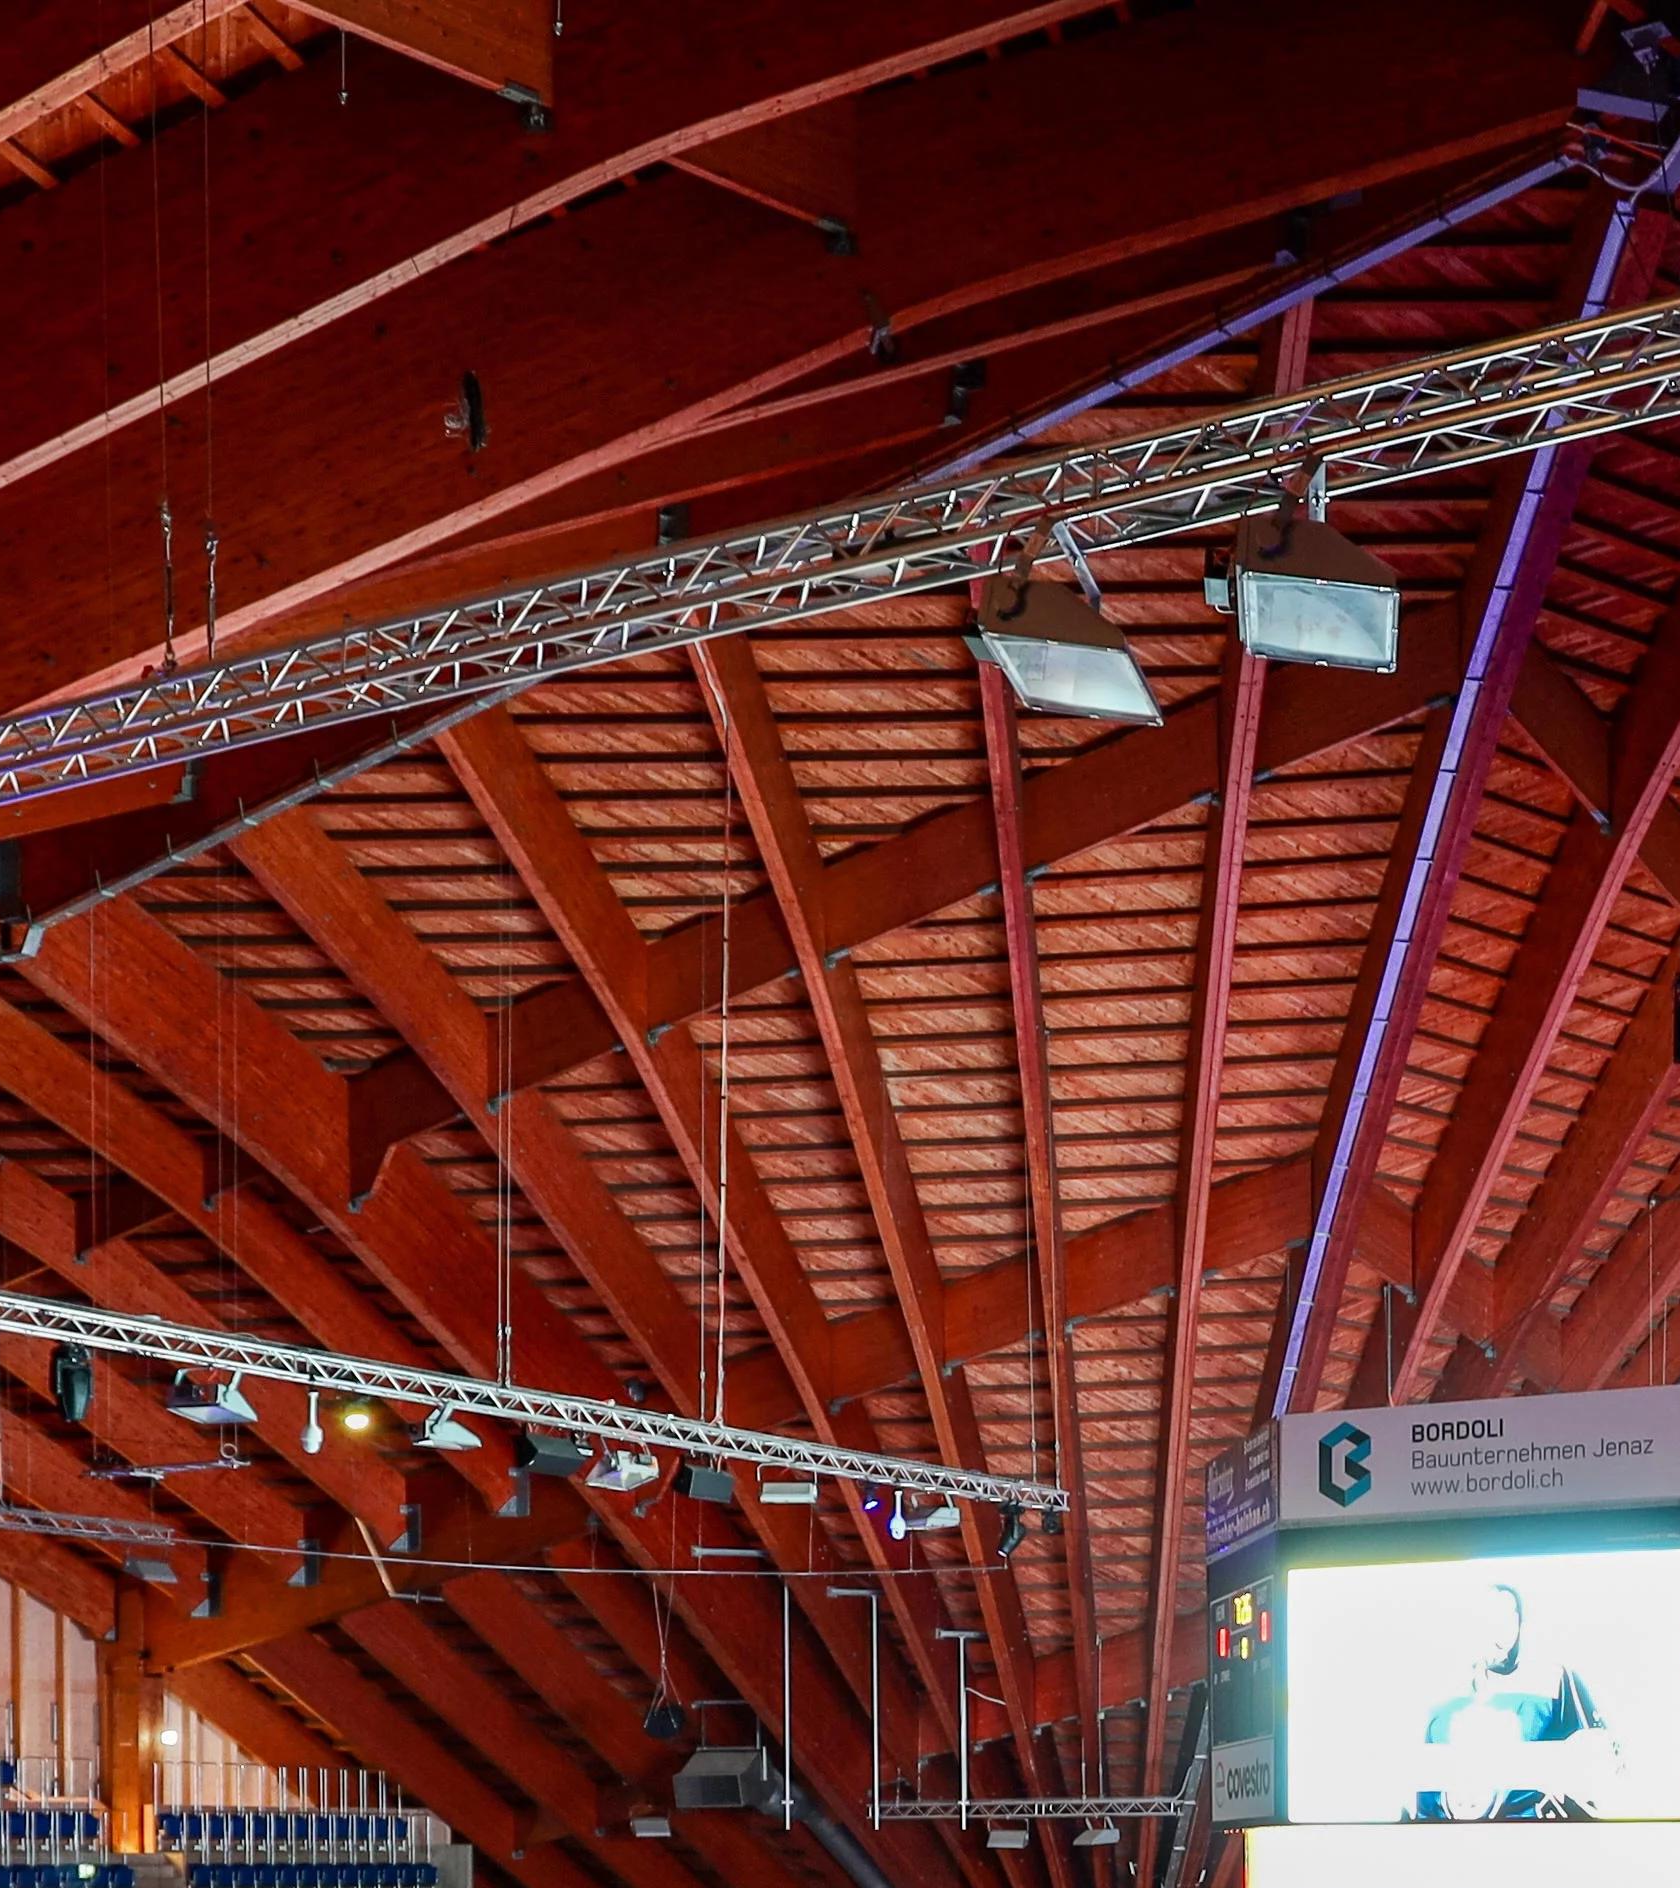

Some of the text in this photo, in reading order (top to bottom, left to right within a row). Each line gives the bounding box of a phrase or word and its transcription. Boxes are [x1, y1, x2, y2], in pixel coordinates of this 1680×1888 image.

[1412, 1419, 1504, 1443] BORDOLI
[1412, 1437, 1654, 1470] Bauunternehmen Jenaz
[1411, 1468, 1563, 1496] www.bordoli.ch
[1227, 1761, 1271, 1801] covestro
